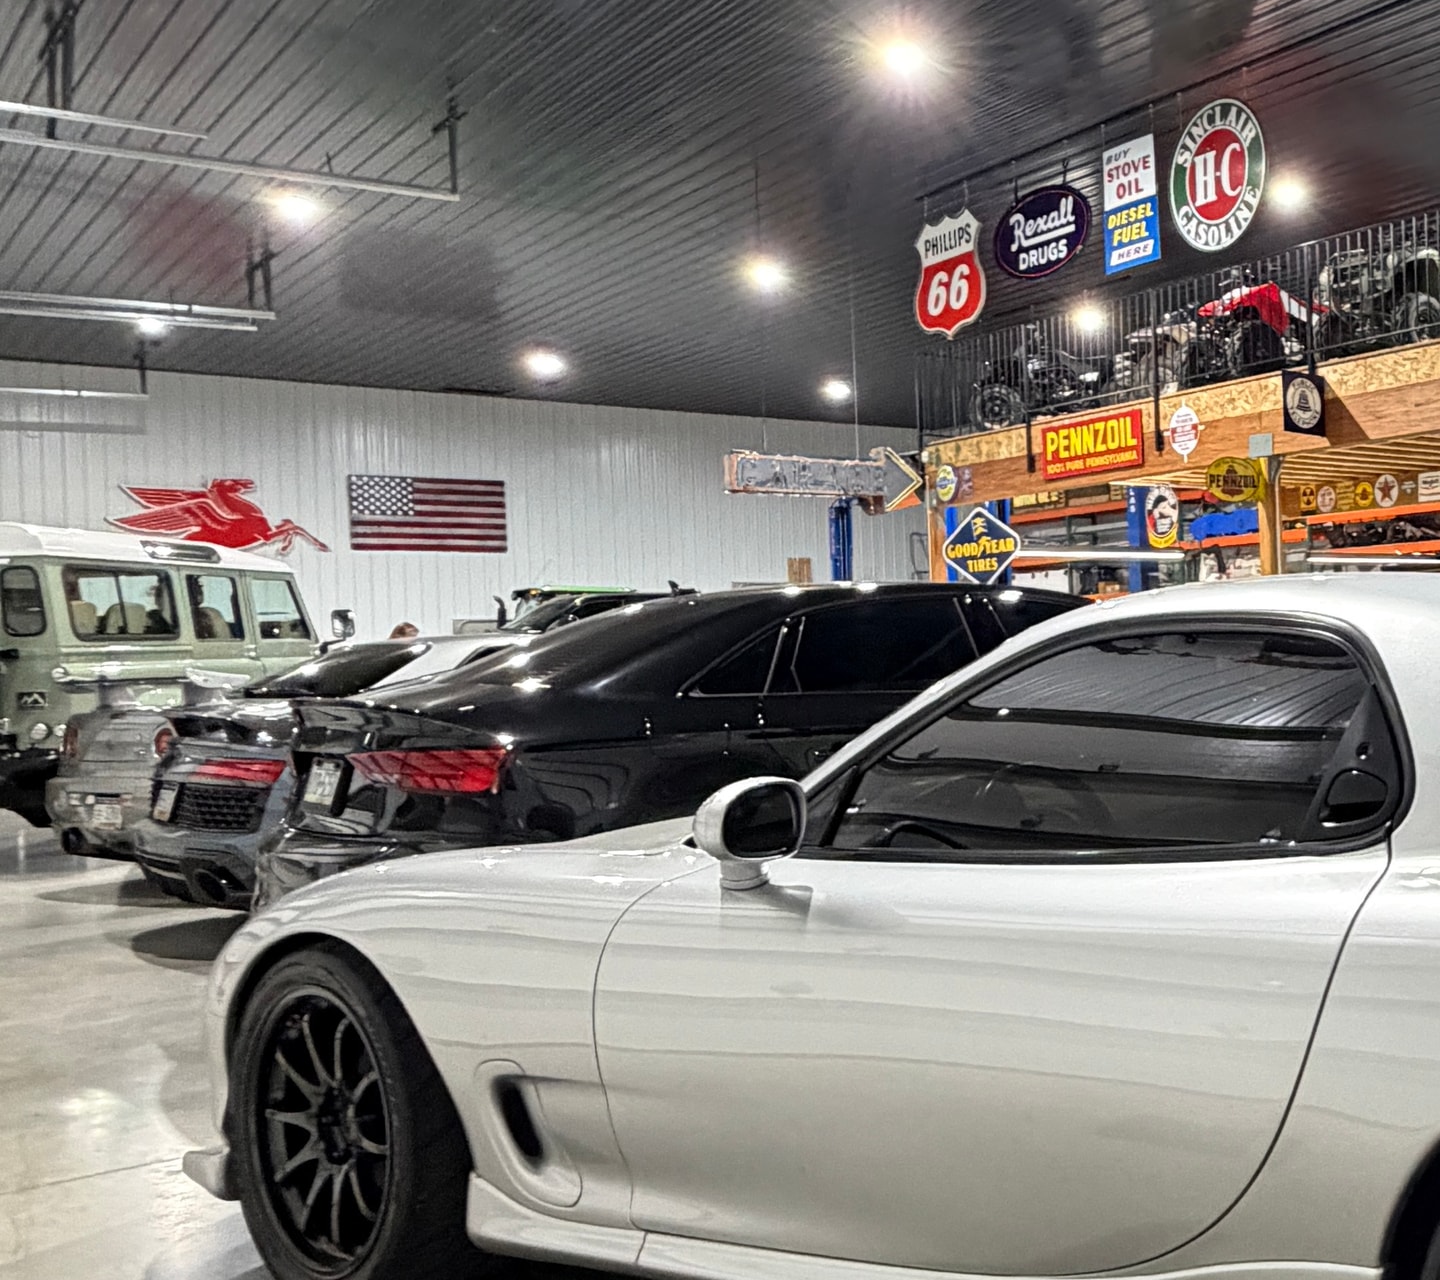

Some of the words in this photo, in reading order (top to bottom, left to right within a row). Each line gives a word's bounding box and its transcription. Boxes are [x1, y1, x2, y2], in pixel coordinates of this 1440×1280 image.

[1177, 106, 1258, 167] SINCLAIR
[1105, 148, 1131, 165] BUY
[1107, 154, 1151, 183] STOVE
[1116, 178, 1144, 199] OIL
[1010, 196, 1075, 252] Rexall
[1108, 202, 1154, 229] DIESEL
[1178, 185, 1260, 247] GASOLINE
[924, 223, 972, 258] PHILLIPS
[1112, 221, 1149, 246] FUEL
[1019, 239, 1067, 270] DRUGS
[1117, 243, 1151, 261] HERE
[927, 264, 970, 317] 66
[1046, 416, 1137, 461] PENNZOIL
[1047, 462, 1065, 475] 100%
[1066, 458, 1085, 470] PURE
[1086, 450, 1138, 468] PENNSYLVANIA
[947, 537, 1015, 559] GOODYEAR
[967, 558, 998, 573] TIRES
